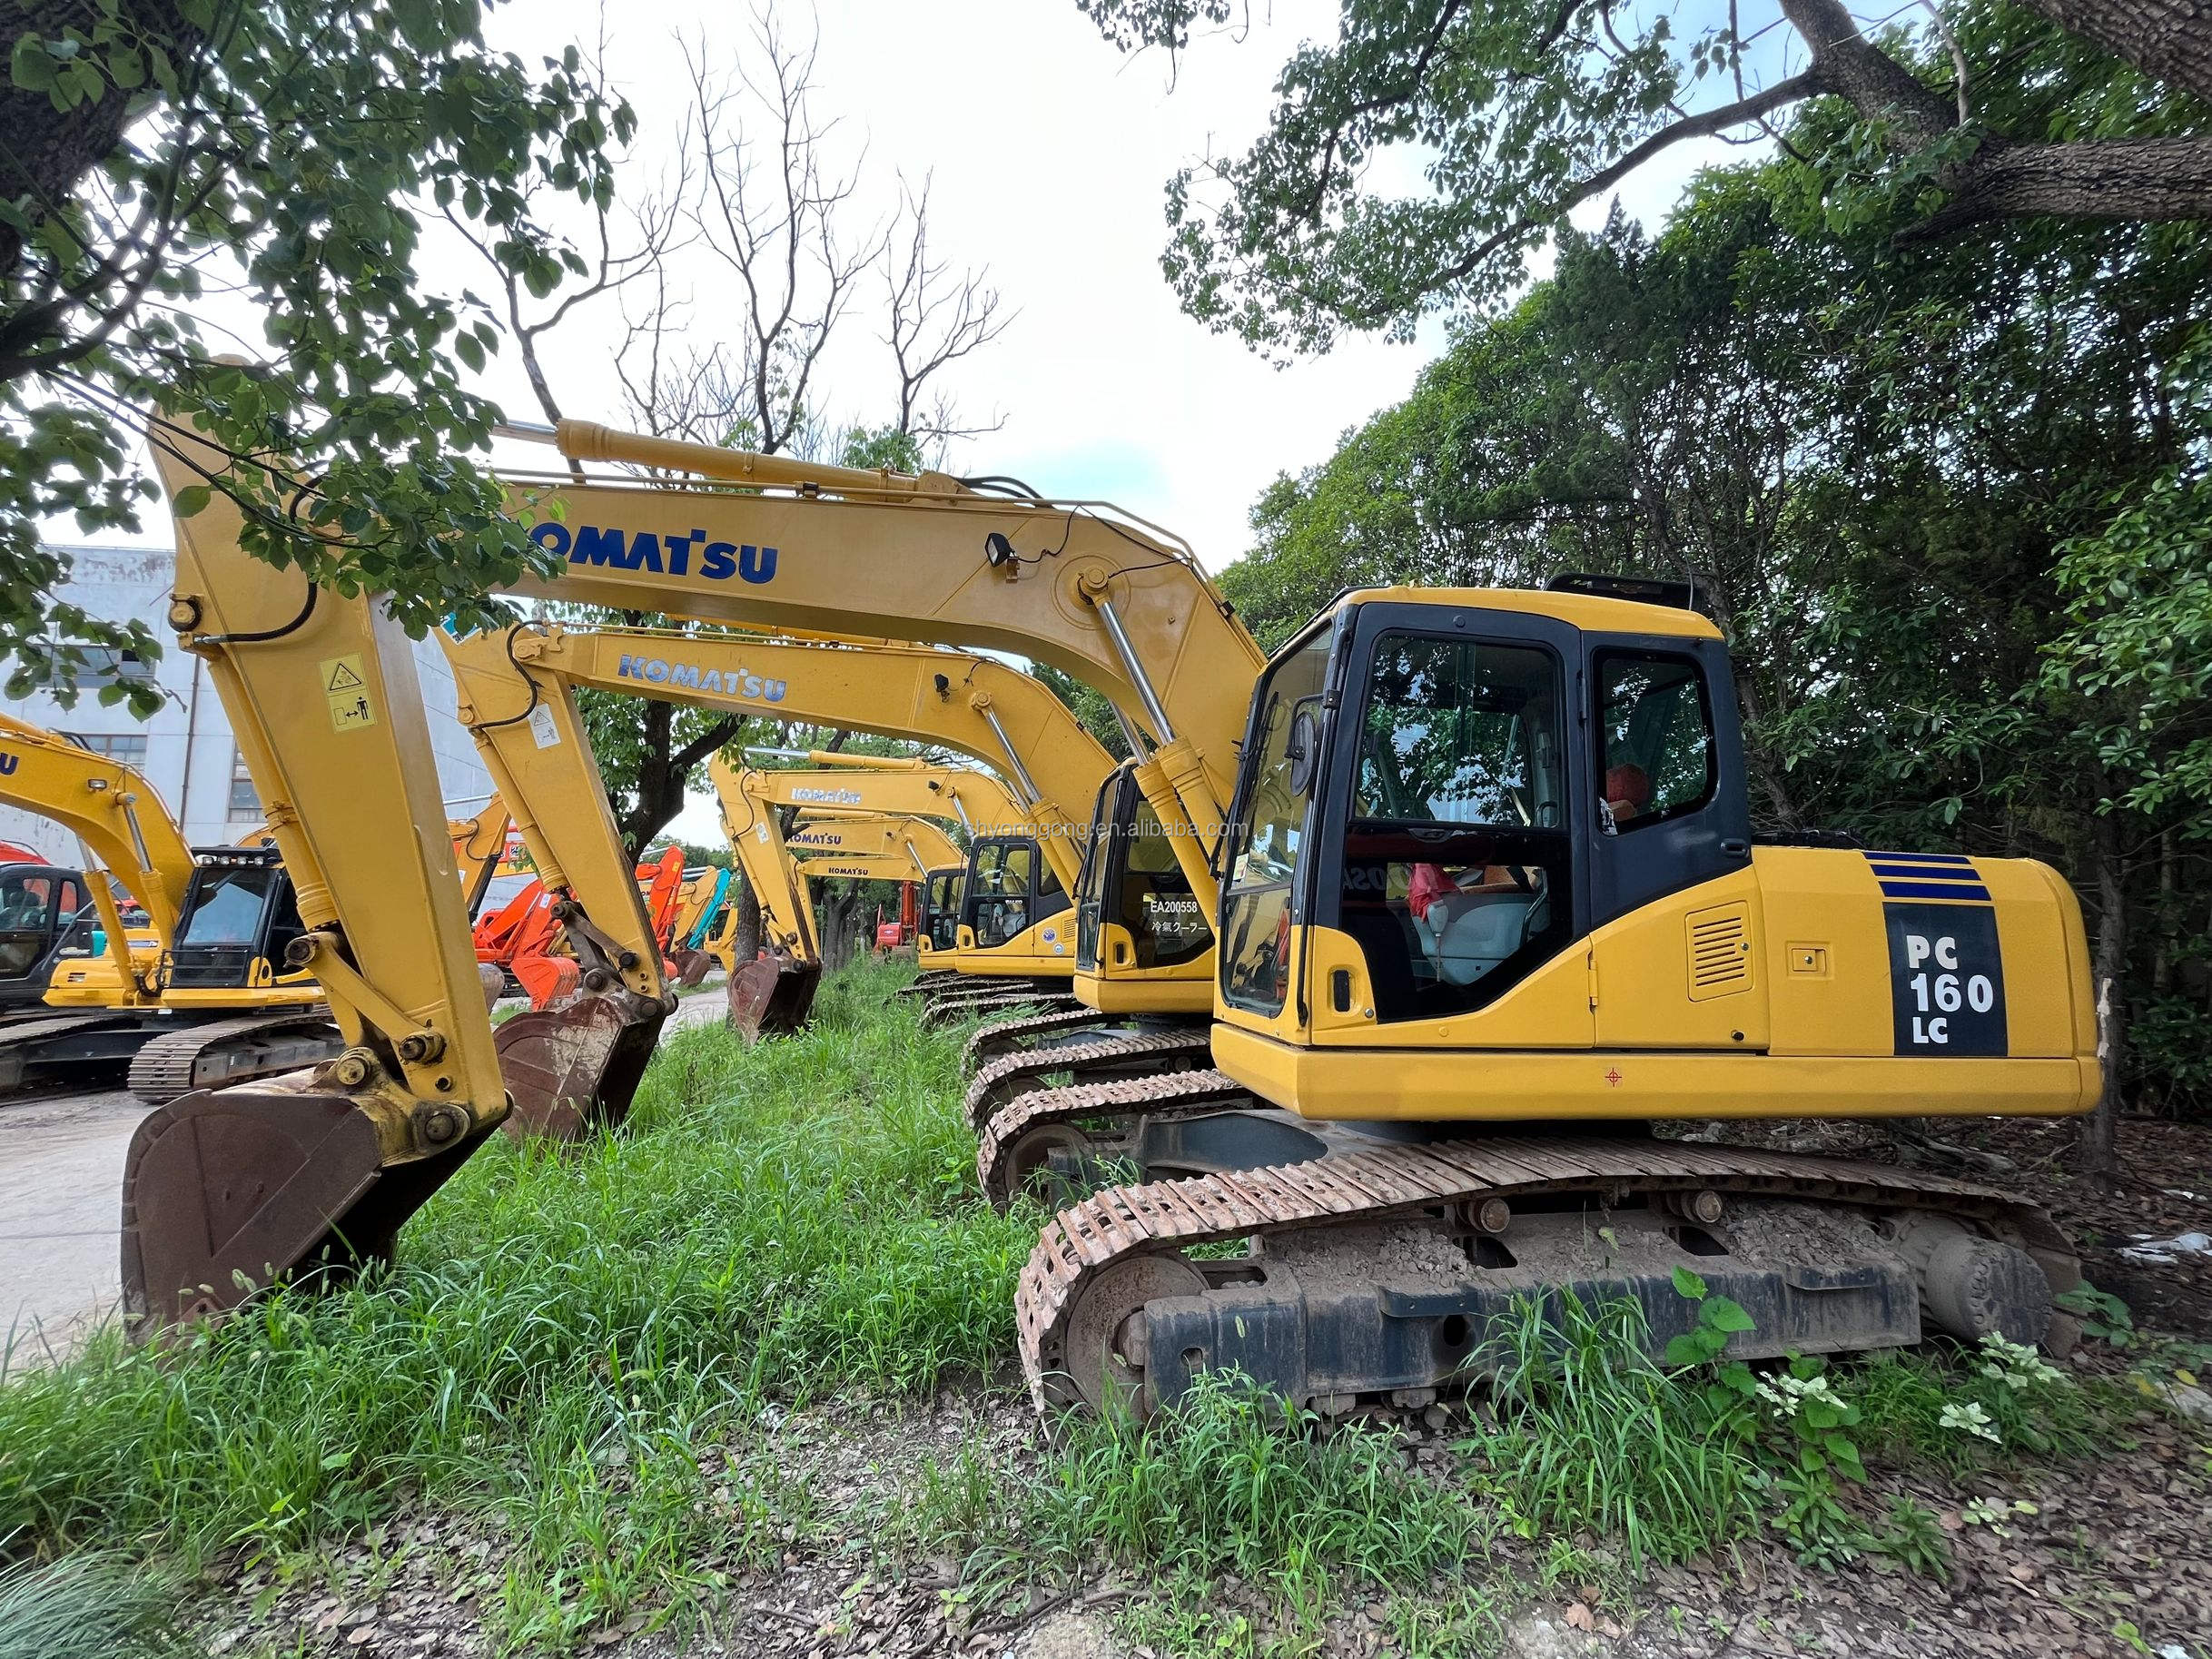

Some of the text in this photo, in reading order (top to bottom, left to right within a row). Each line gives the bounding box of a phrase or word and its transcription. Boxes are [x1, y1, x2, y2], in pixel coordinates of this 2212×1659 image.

[528, 522, 779, 584] OMATSU
[617, 654, 787, 702] KOMATSU
[828, 867, 868, 875] KOMATSU
[1150, 901, 1198, 913] EA200558
[1906, 934, 1958, 970] PC
[1911, 973, 1994, 1013] 160
[1912, 1017, 1949, 1044] LC
